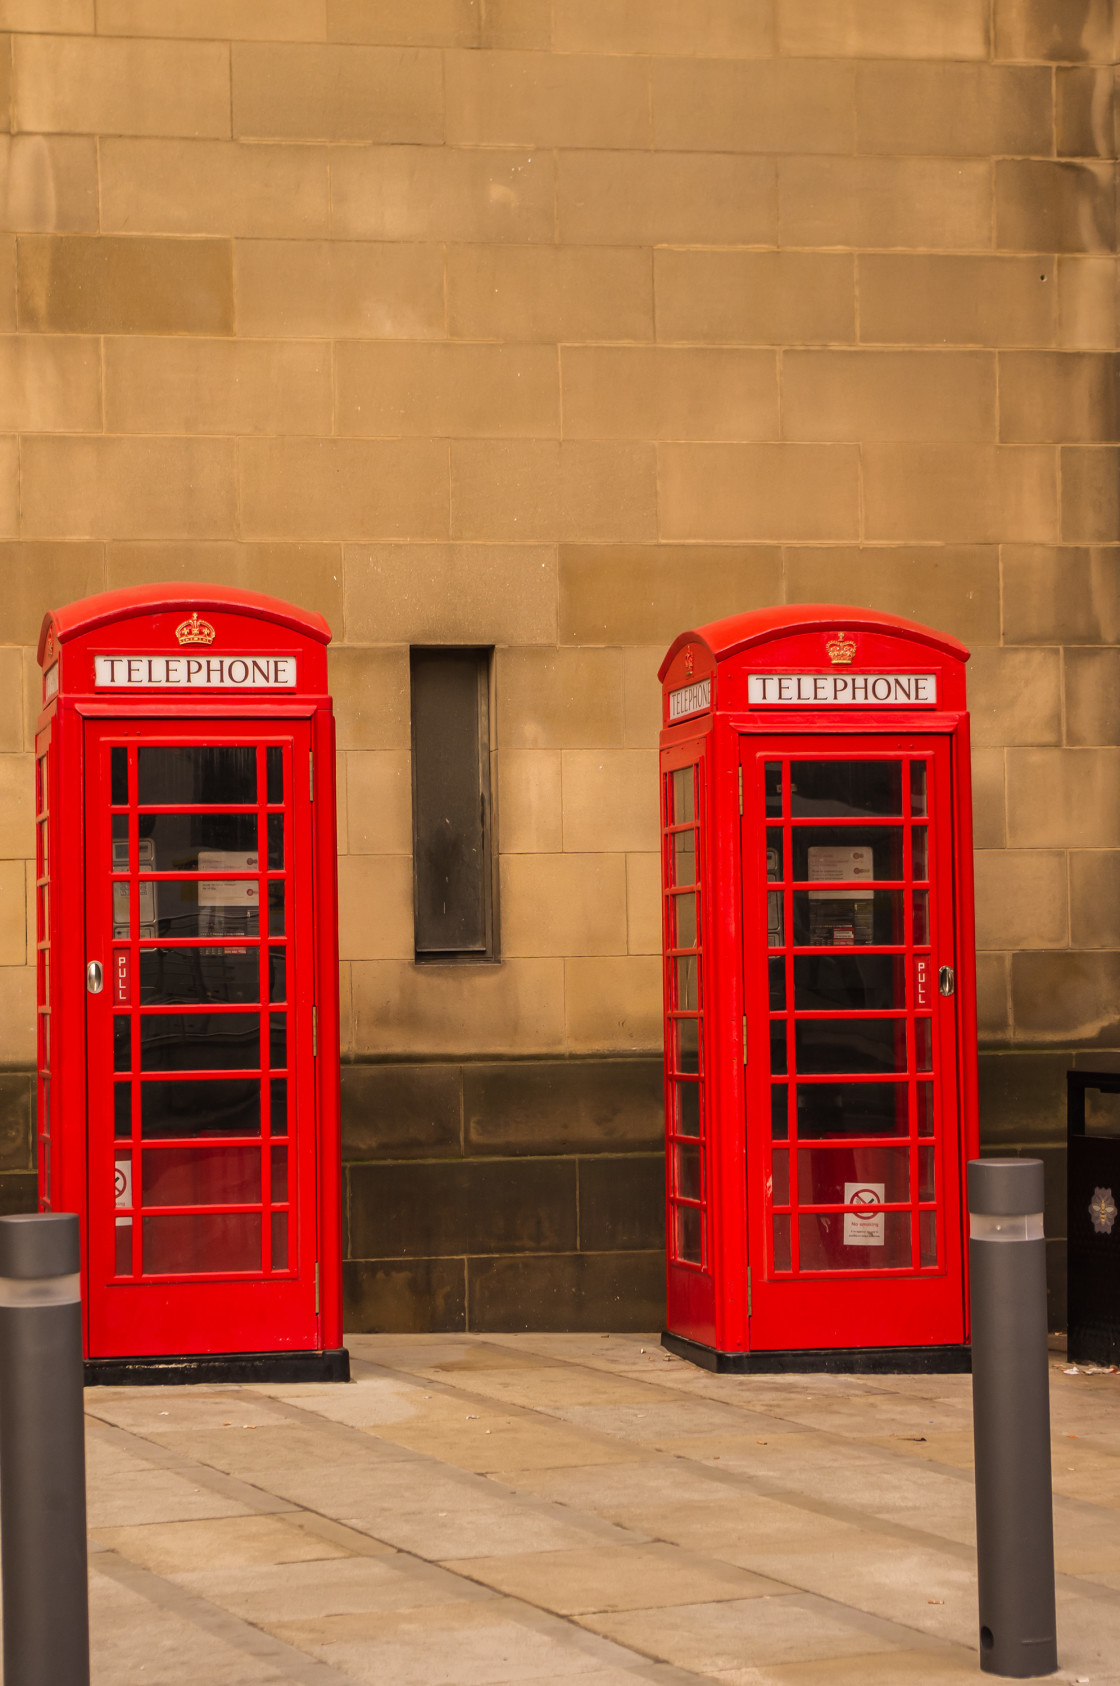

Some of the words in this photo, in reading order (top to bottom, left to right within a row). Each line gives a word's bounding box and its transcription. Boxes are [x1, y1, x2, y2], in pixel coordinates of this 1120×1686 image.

[103, 659, 289, 684] TELEPHONE
[672, 682, 710, 716] TELEPHONE
[756, 677, 928, 701] TELEPHONE
[118, 956, 127, 1000] PULL
[918, 962, 926, 1004] PULL
